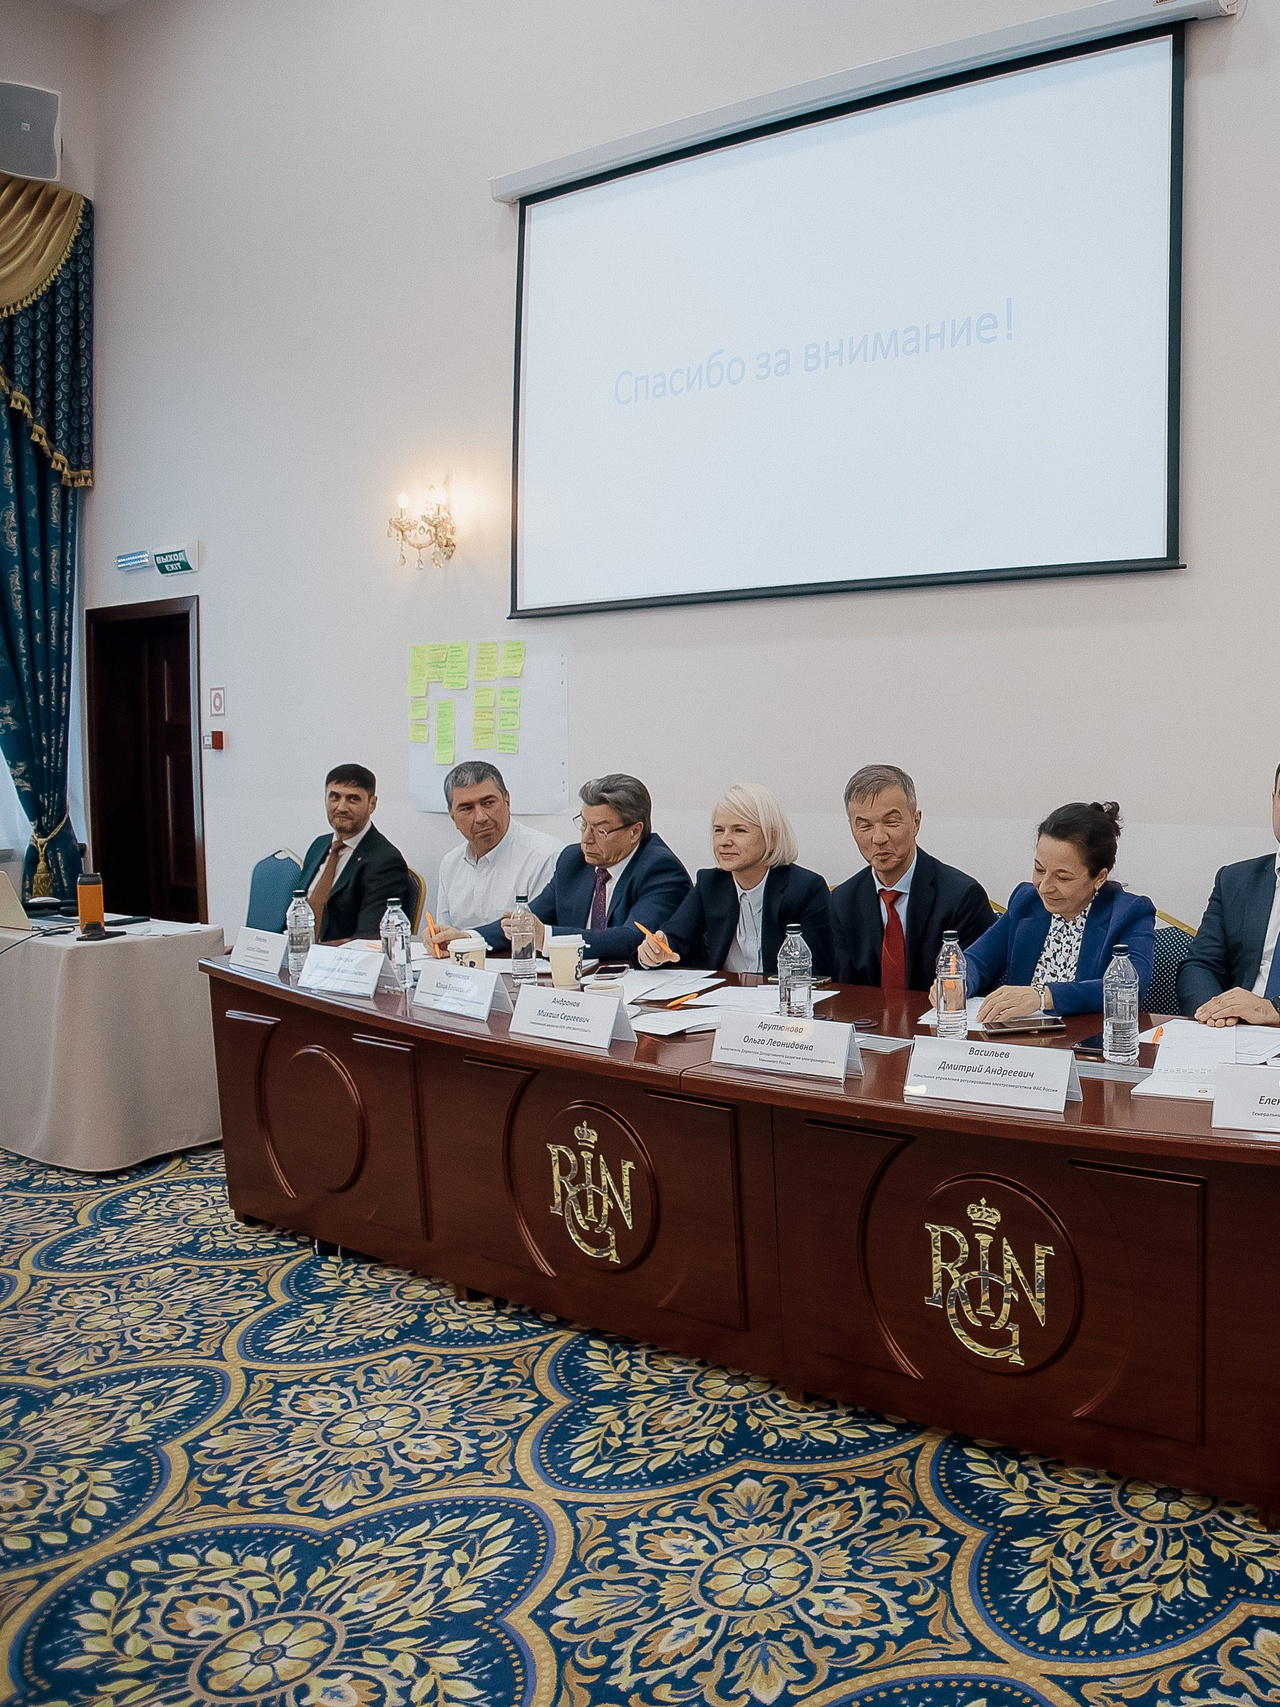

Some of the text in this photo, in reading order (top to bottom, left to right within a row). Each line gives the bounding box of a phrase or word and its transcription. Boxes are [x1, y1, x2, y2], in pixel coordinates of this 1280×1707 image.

[614, 296, 1014, 406] Спасибо за внимание!
[155, 552, 185, 564] ВЫХОД
[165, 563, 182, 572] EXIT
[551, 997, 581, 1008] Андронов
[536, 1009, 590, 1024] Михаил Сергеевич
[757, 1021, 804, 1034] Арутюнова
[743, 1035, 814, 1052] Ольга Леонидовна
[968, 1047, 1010, 1059] Васильев
[937, 1060, 1035, 1079] Дмитрий Андреевич
